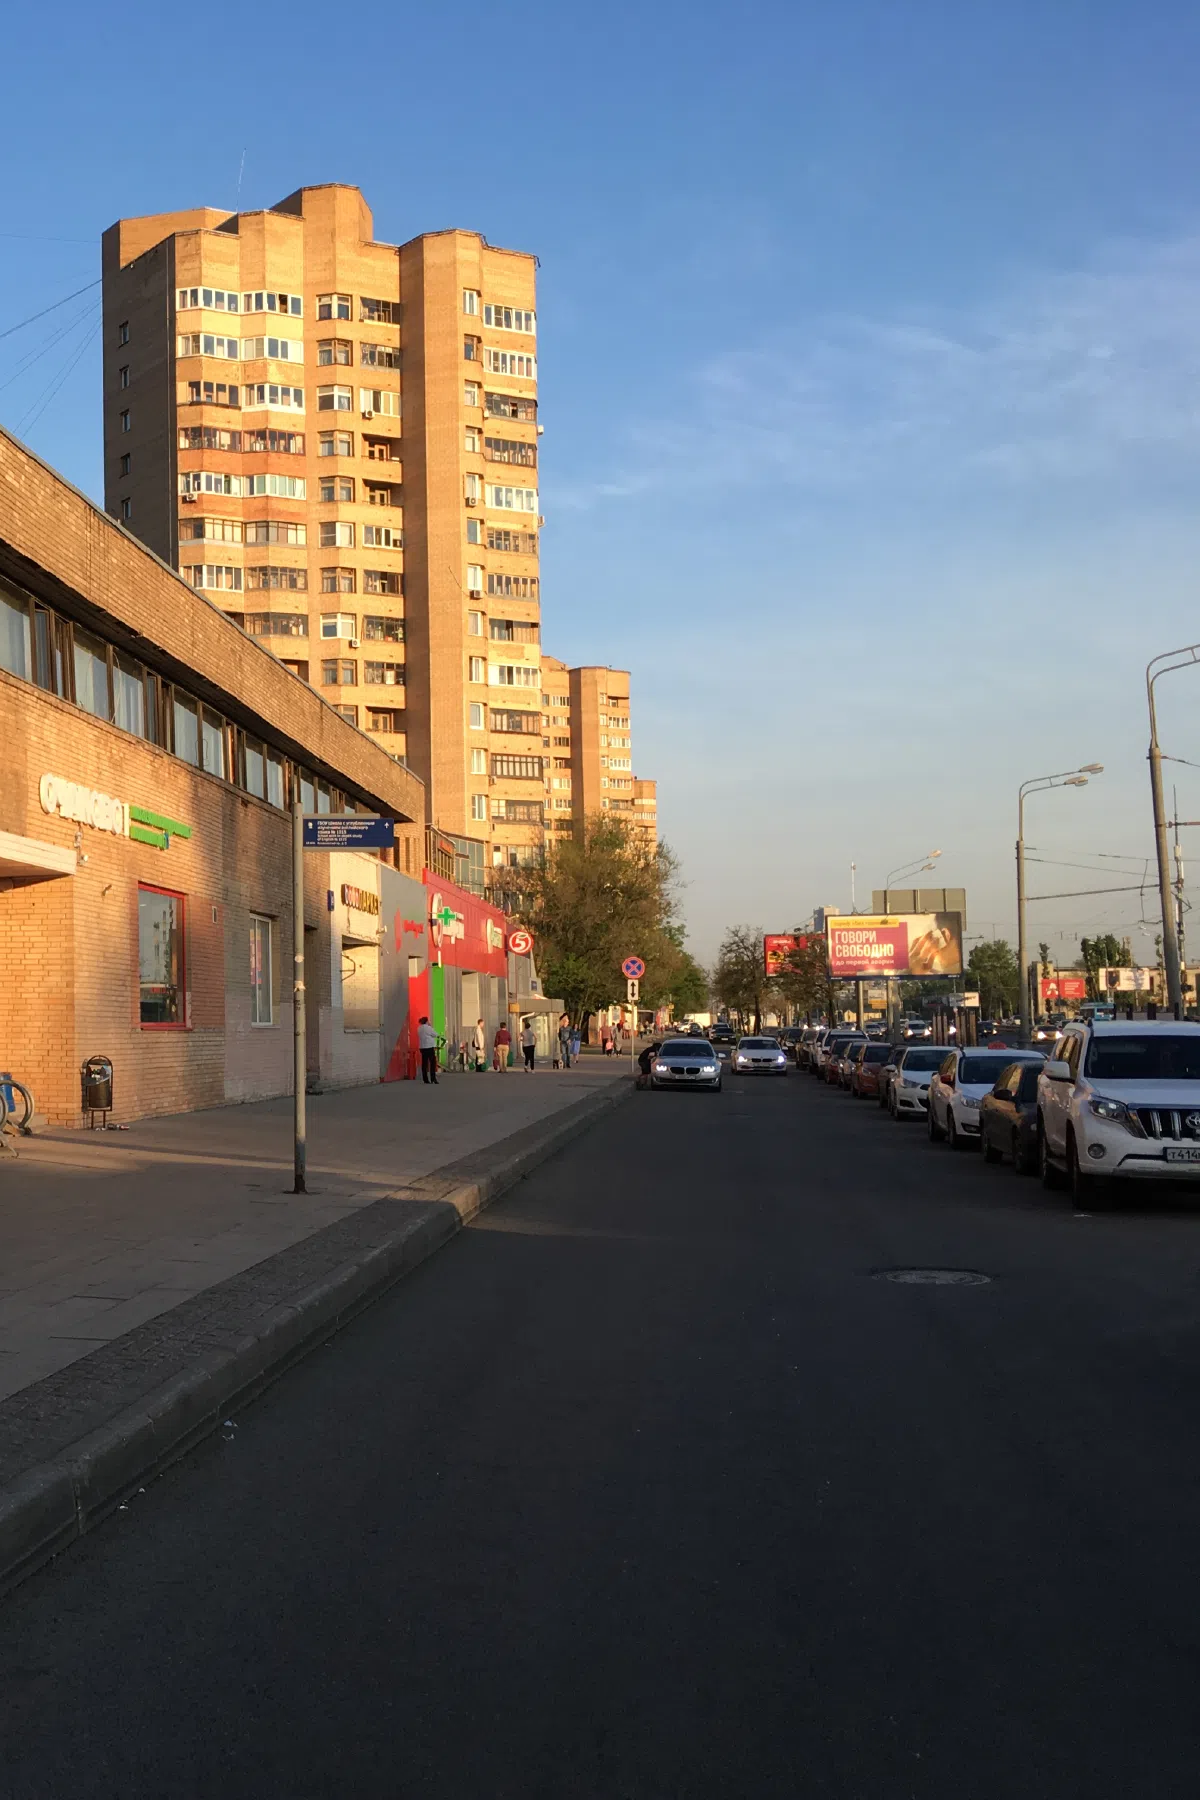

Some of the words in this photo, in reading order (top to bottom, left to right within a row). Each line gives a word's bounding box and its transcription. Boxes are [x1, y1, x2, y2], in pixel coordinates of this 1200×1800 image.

[835, 930, 877, 944] ГОВОРИ
[835, 944, 894, 958] СВОБОДНО
[1171, 1150, 1200, 1160] Т414
